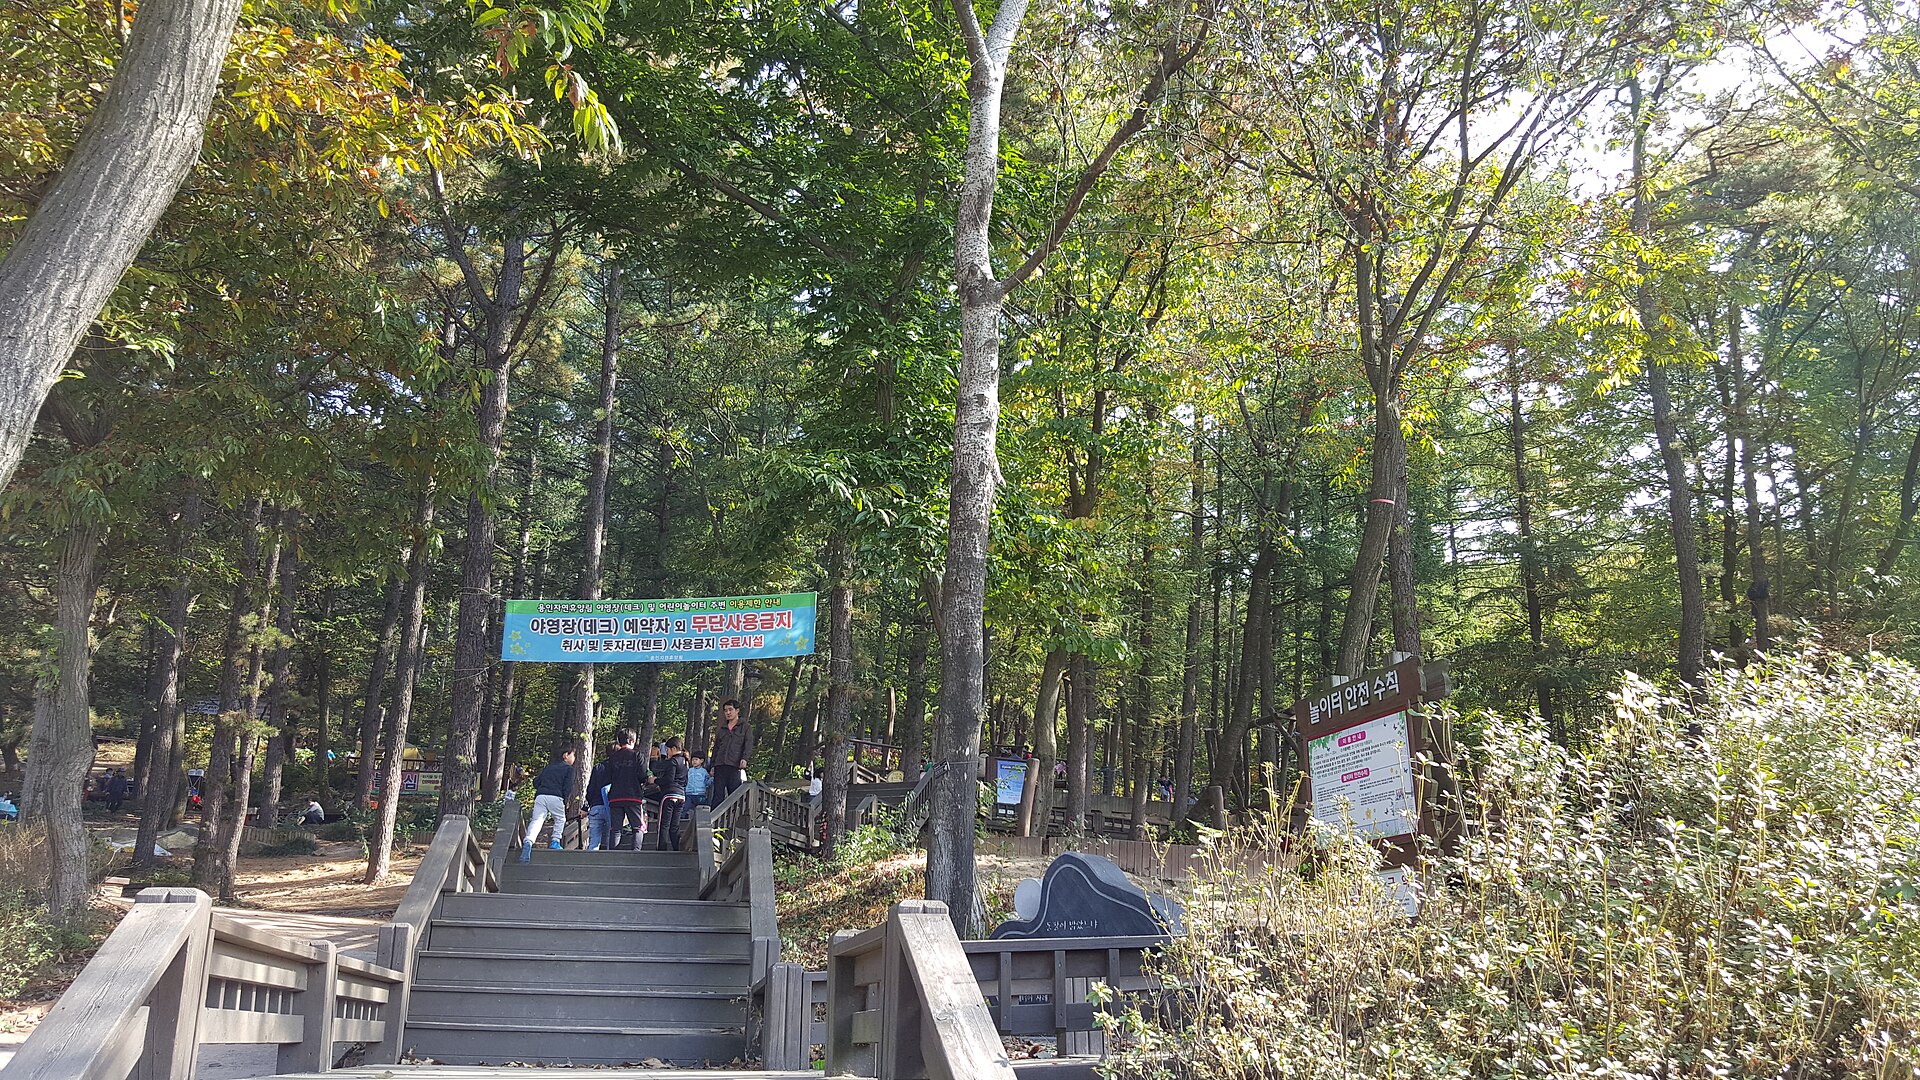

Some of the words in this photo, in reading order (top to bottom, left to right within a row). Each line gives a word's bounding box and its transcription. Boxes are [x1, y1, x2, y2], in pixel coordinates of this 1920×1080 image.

[537, 603, 593, 613] 용인자연휴양림
[596, 602, 644, 613] 야영장(데크)
[647, 602, 656, 612] 및
[658, 600, 707, 611] 어린이놀이터
[710, 600, 726, 610] 주변
[729, 598, 762, 609] 이용제한
[764, 597, 781, 608] 안내
[530, 617, 619, 636] 야영장(데크)
[623, 616, 670, 635] 예약자
[674, 619, 686, 633] 외
[691, 610, 793, 633] 무단사용금지
[562, 638, 586, 652] 취사
[588, 639, 599, 652] 및
[602, 637, 668, 652] 돗자리(텐트)
[671, 636, 715, 650] 사용금지
[719, 634, 764, 649] 유료시설
[1309, 690, 1343, 725] 놀이터
[1345, 680, 1370, 711] 안전
[1373, 669, 1400, 700] 수칙
